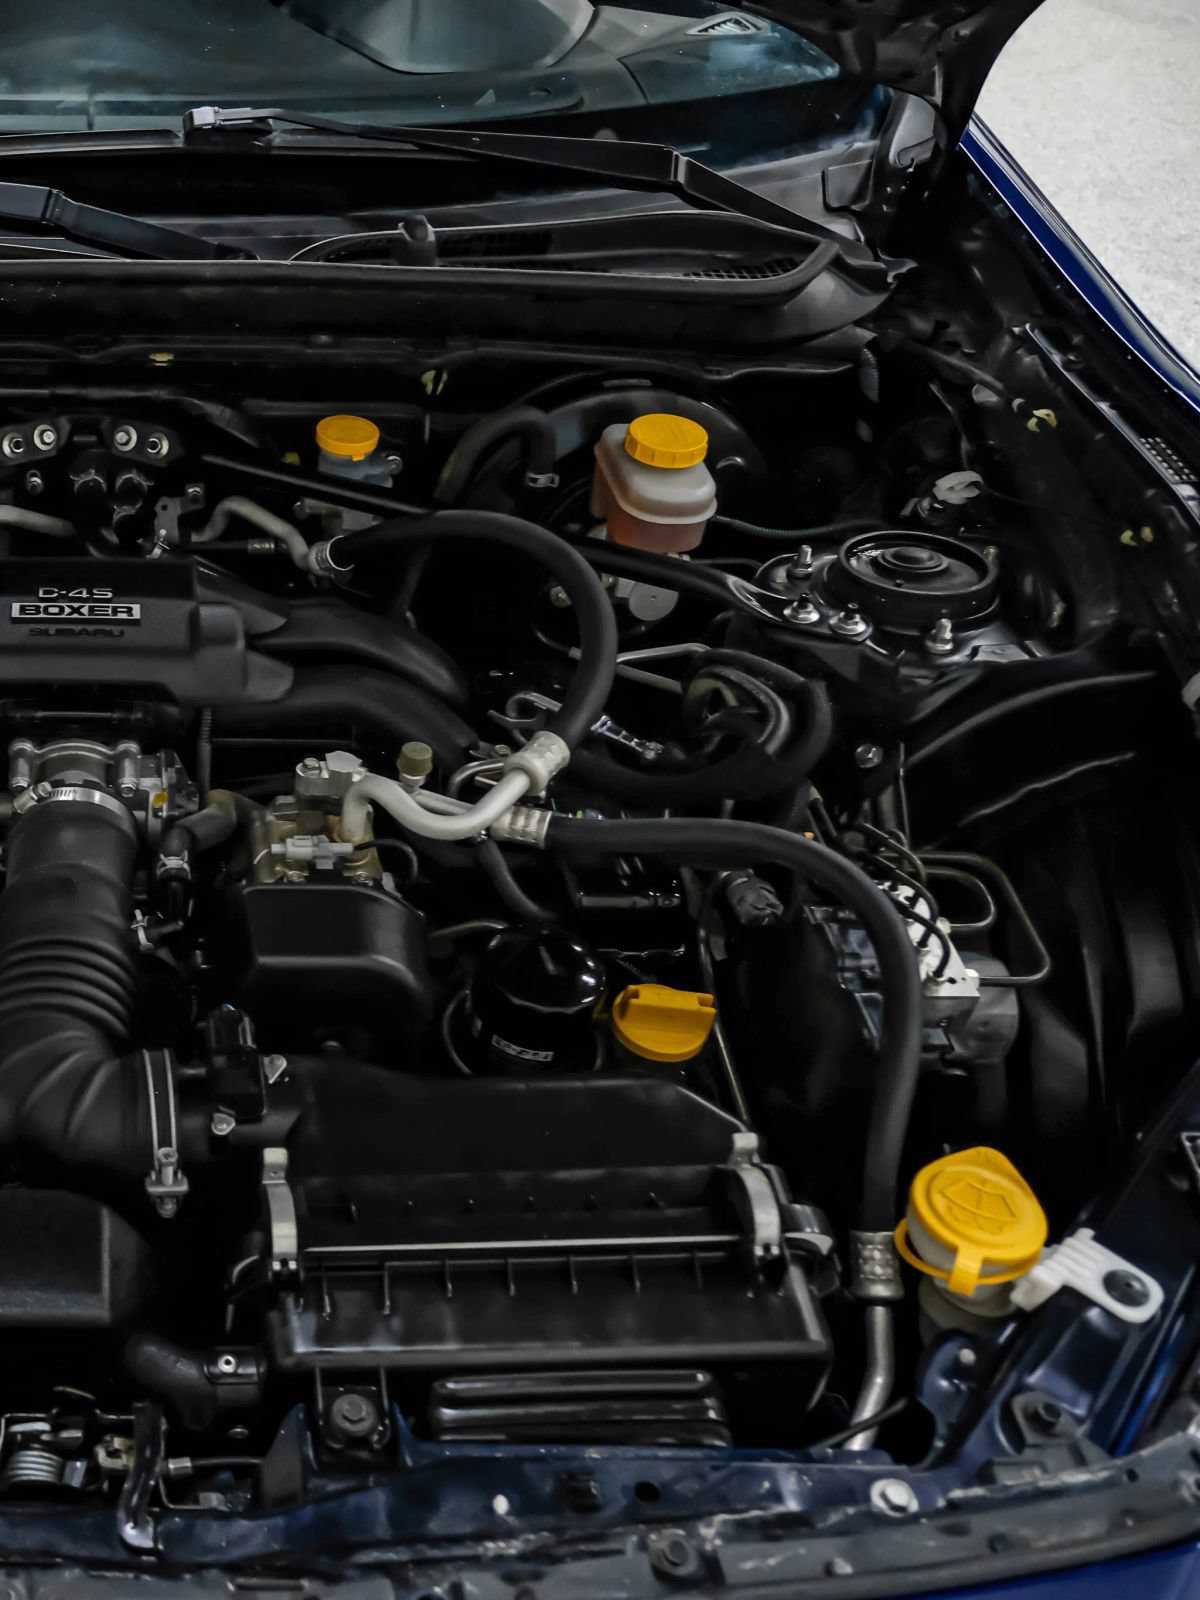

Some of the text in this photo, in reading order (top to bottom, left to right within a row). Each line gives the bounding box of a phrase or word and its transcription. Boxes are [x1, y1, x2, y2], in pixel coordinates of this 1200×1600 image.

[38, 587, 113, 599] D-4S
[18, 604, 134, 617] BOXER
[28, 627, 125, 638] SUBARU
